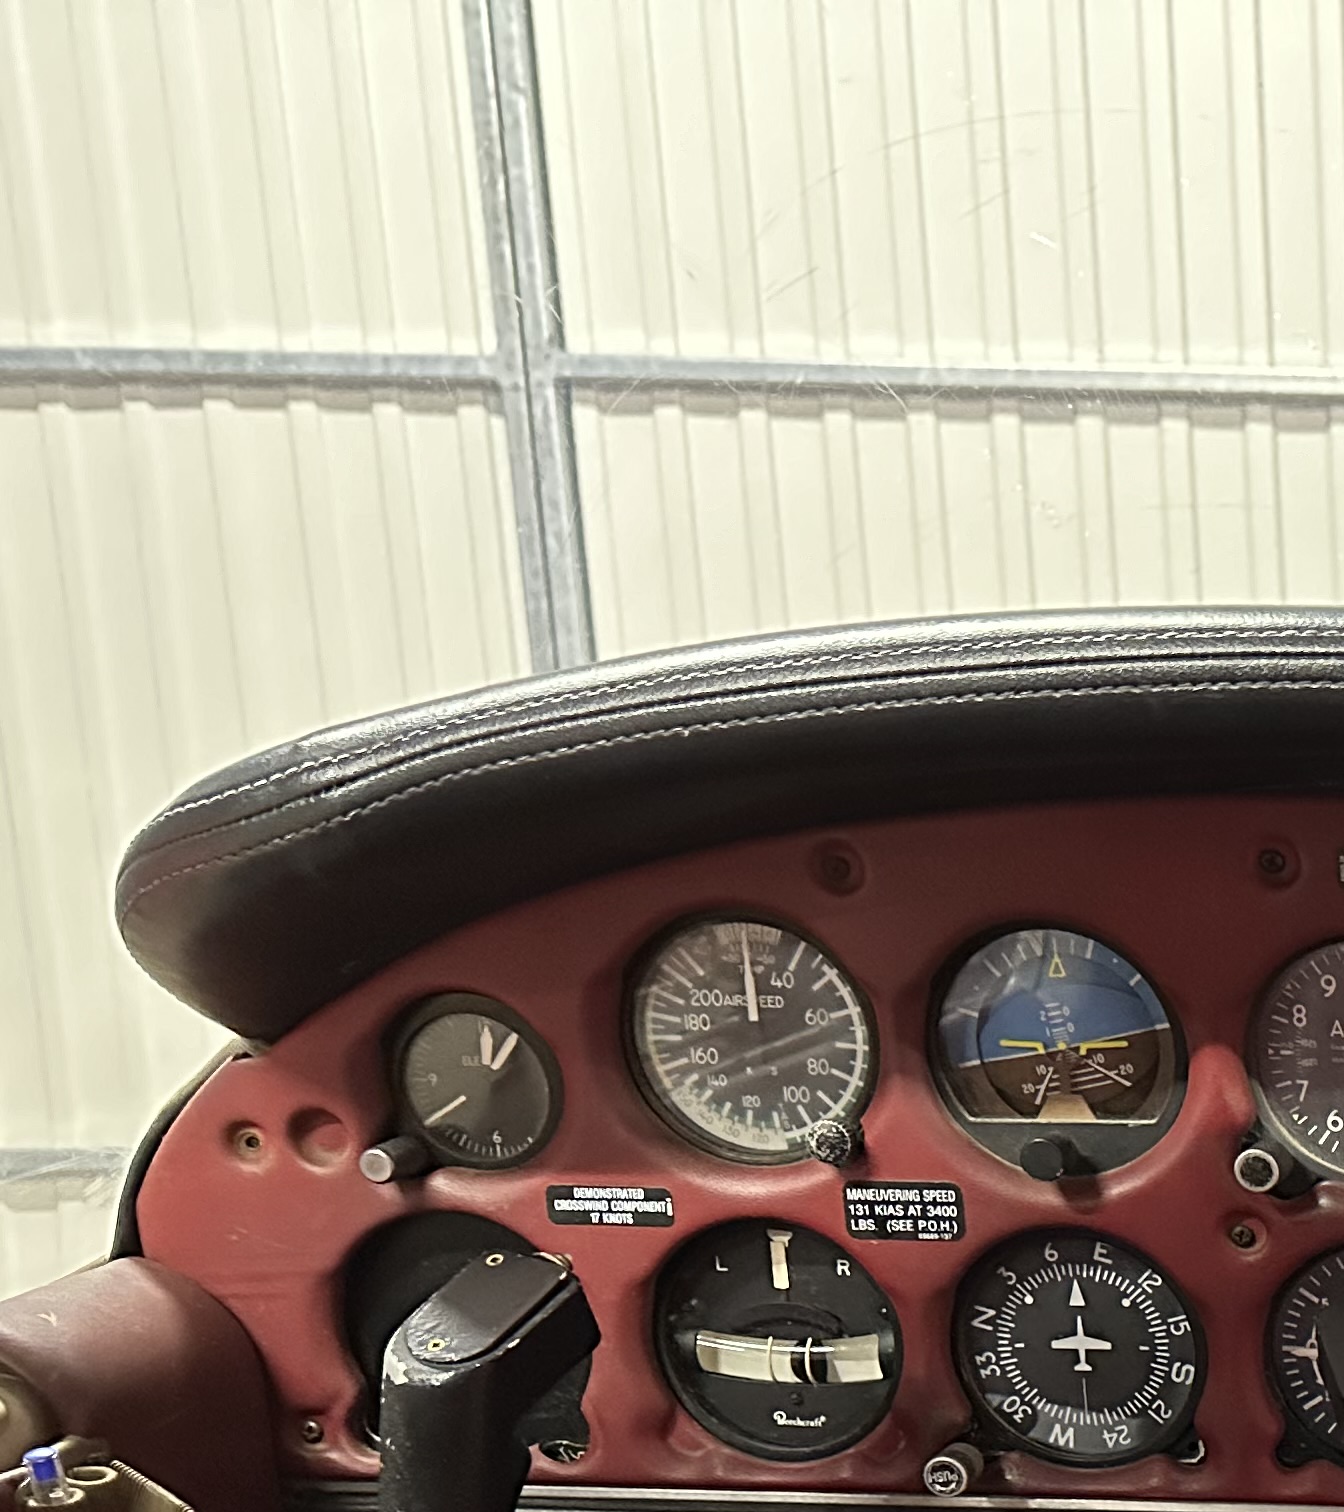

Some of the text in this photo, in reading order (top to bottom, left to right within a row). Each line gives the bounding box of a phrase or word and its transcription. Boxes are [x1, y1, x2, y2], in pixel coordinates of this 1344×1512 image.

[783, 1087, 810, 1103] 100
[573, 1187, 644, 1200] DEMONSTRATED
[847, 1189, 956, 1202] MANEUVERING SPEED
[554, 1200, 665, 1213] CROSSWIND COMPONENT
[849, 1205, 957, 1217] 131 KIAS AT 3400
[850, 1219, 957, 1234] LBS. (SEE P.O.H.)
[773, 1411, 823, 1427] Beechcraft
